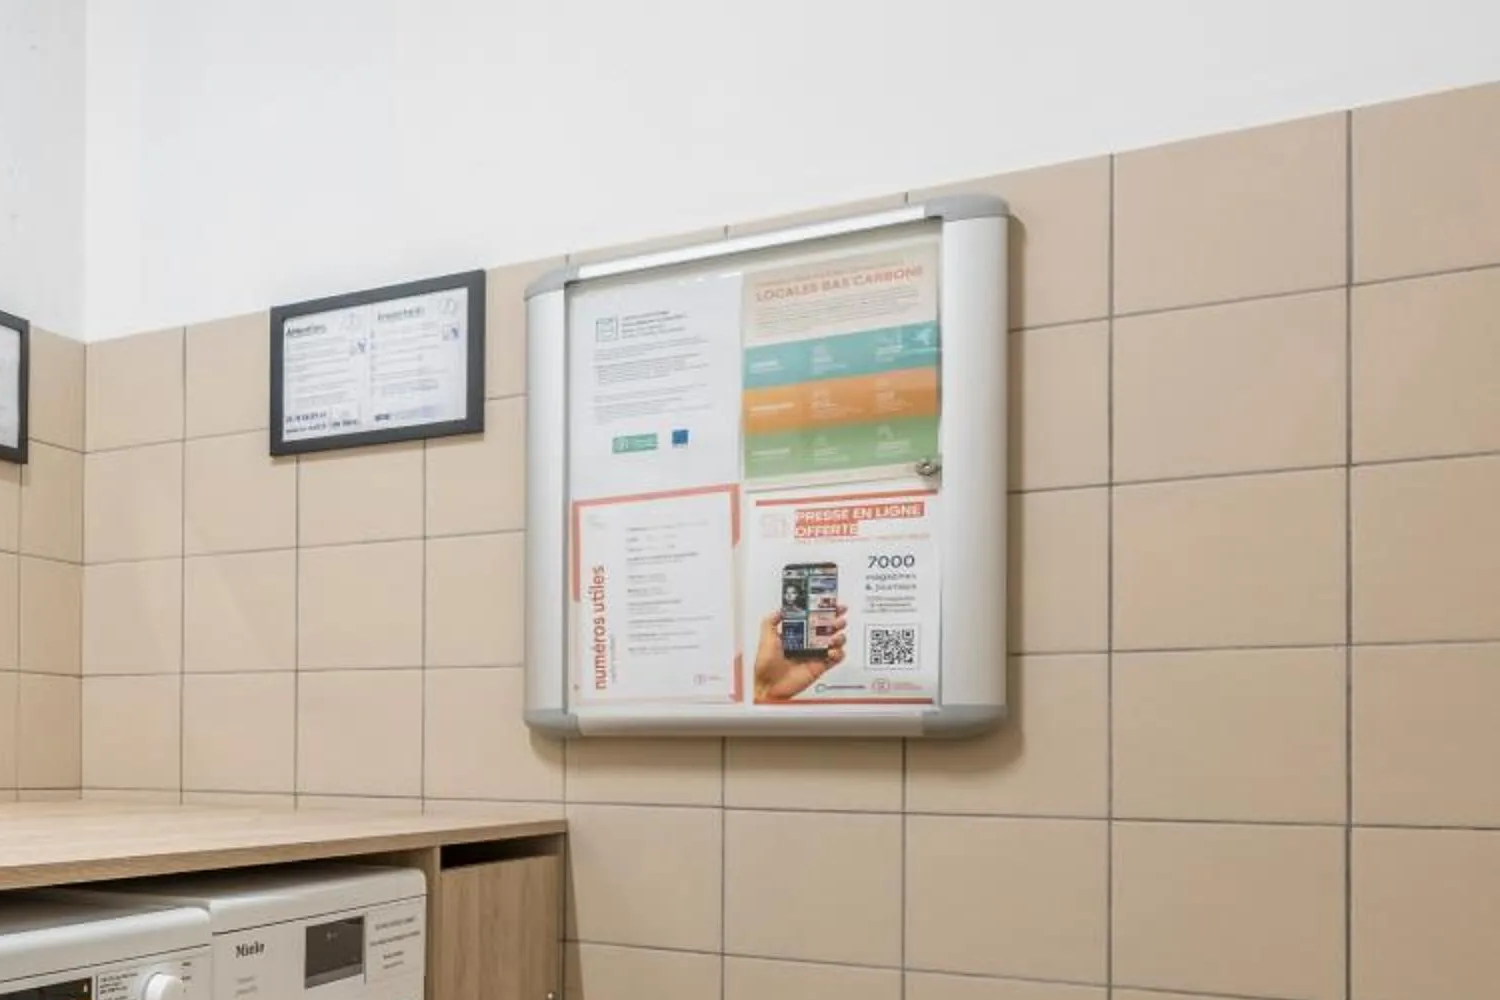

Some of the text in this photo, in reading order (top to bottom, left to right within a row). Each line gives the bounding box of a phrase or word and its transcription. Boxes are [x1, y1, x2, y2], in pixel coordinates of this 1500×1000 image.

[756, 282, 818, 302] LOCALES
[796, 502, 922, 523] PRESSE EN LIGNE
[867, 554, 916, 569] 7000
[587, 564, 607, 690] numéros utiles
[235, 940, 265, 959] Miele
